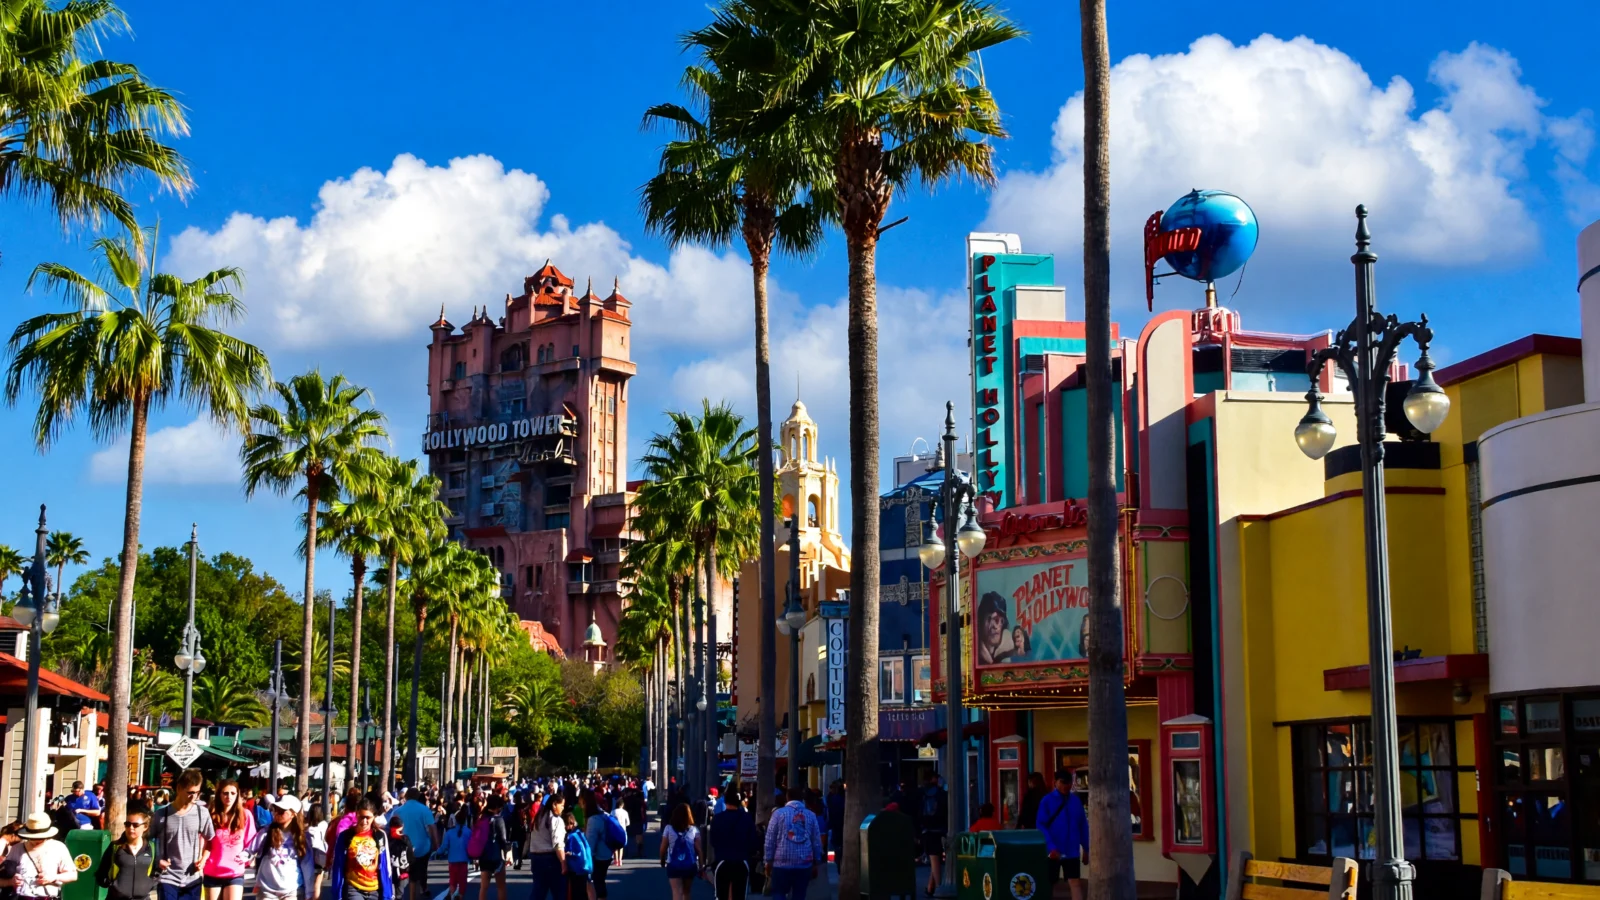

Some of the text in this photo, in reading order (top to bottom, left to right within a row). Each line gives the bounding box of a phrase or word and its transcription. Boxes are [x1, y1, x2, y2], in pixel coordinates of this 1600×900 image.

[982, 255, 1003, 510] PLANET HOLLYW
[422, 423, 508, 452] HOLLYWOOD
[512, 415, 564, 439] TOWER
[1012, 564, 1074, 619] PLANET
[1016, 586, 1089, 636] HOLLYWO
